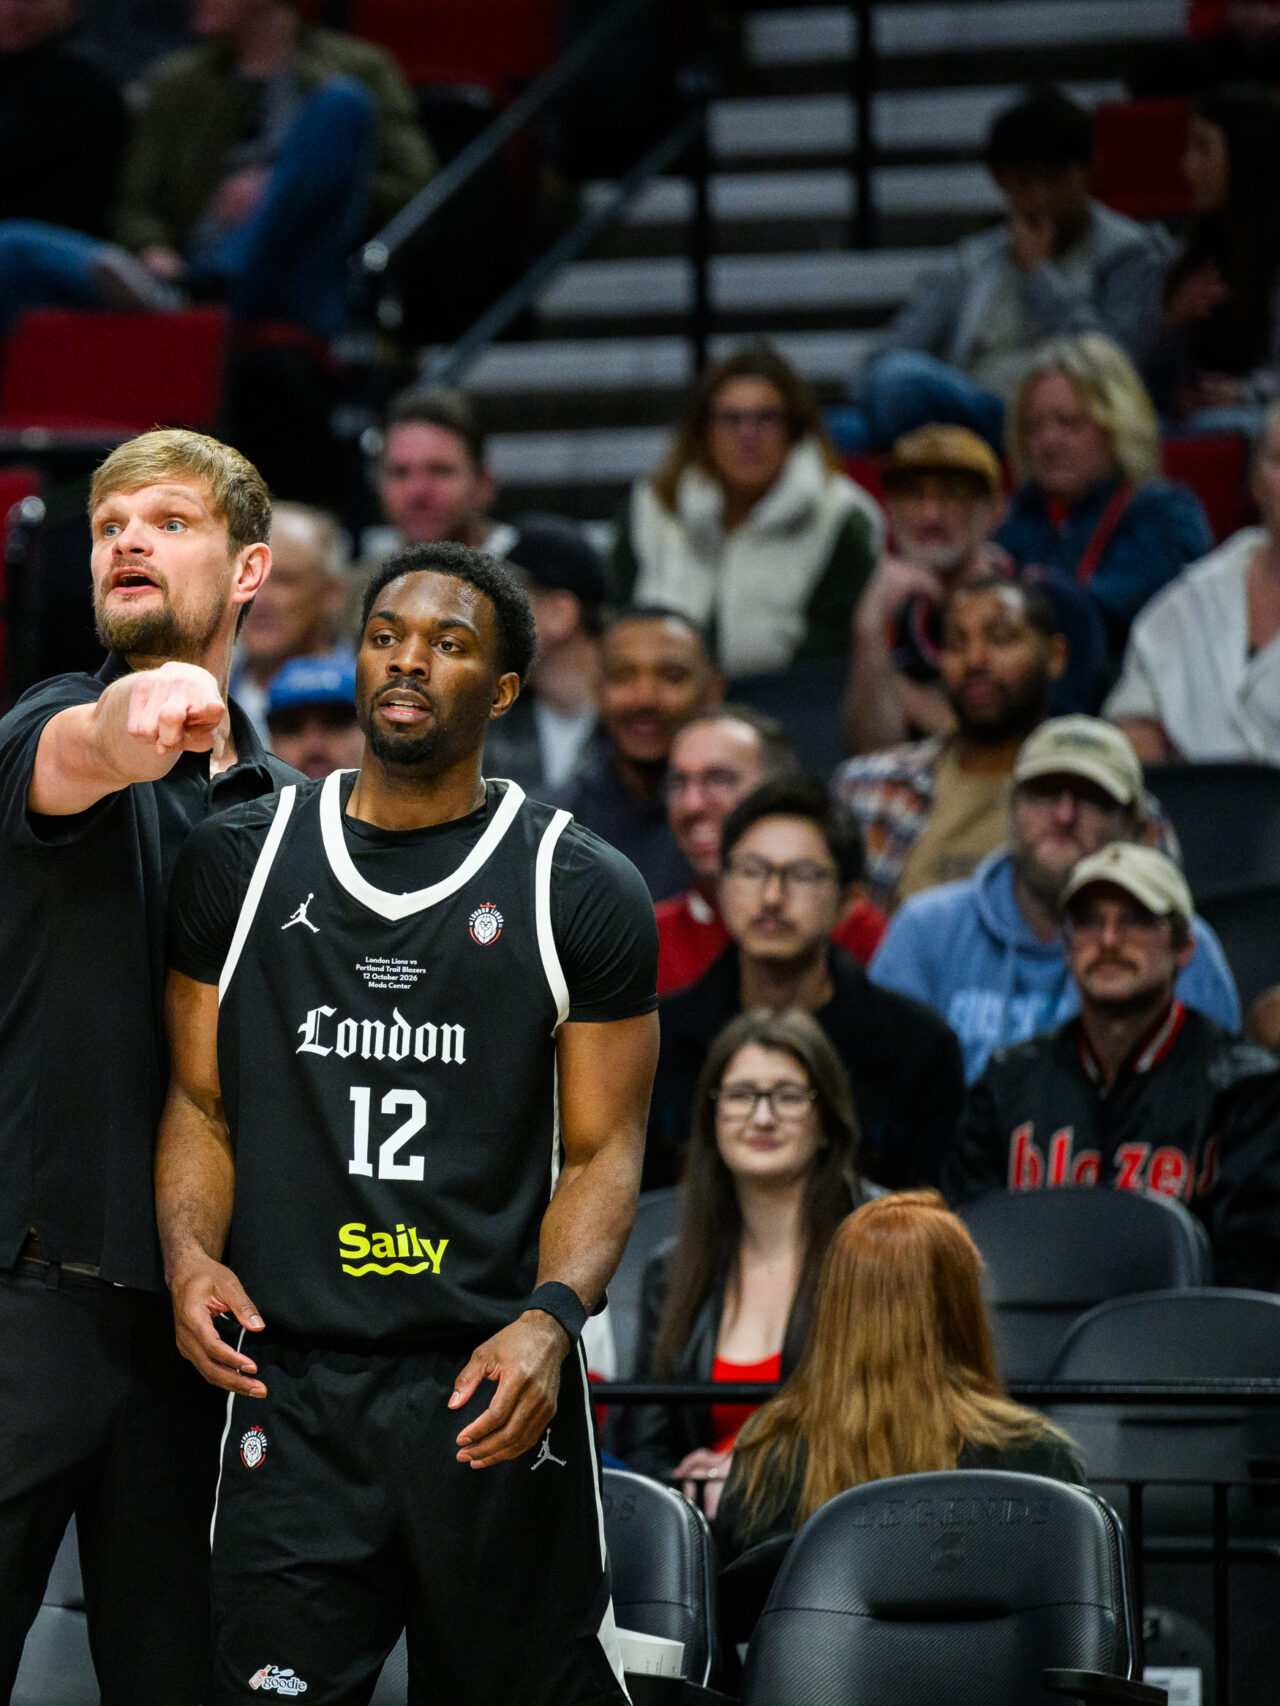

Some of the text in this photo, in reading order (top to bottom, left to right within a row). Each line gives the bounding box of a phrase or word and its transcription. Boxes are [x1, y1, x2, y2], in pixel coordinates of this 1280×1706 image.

[365, 956, 390, 964] London
[391, 957, 408, 965] Lions
[355, 964, 384, 972] Portland
[402, 966, 426, 974] Blazers
[371, 973, 398, 981] October
[388, 982, 411, 990] Center
[296, 1005, 466, 1065] London
[348, 1086, 427, 1181] 12
[338, 1222, 449, 1275] Saily
[263, 1678, 306, 1691] goodie
